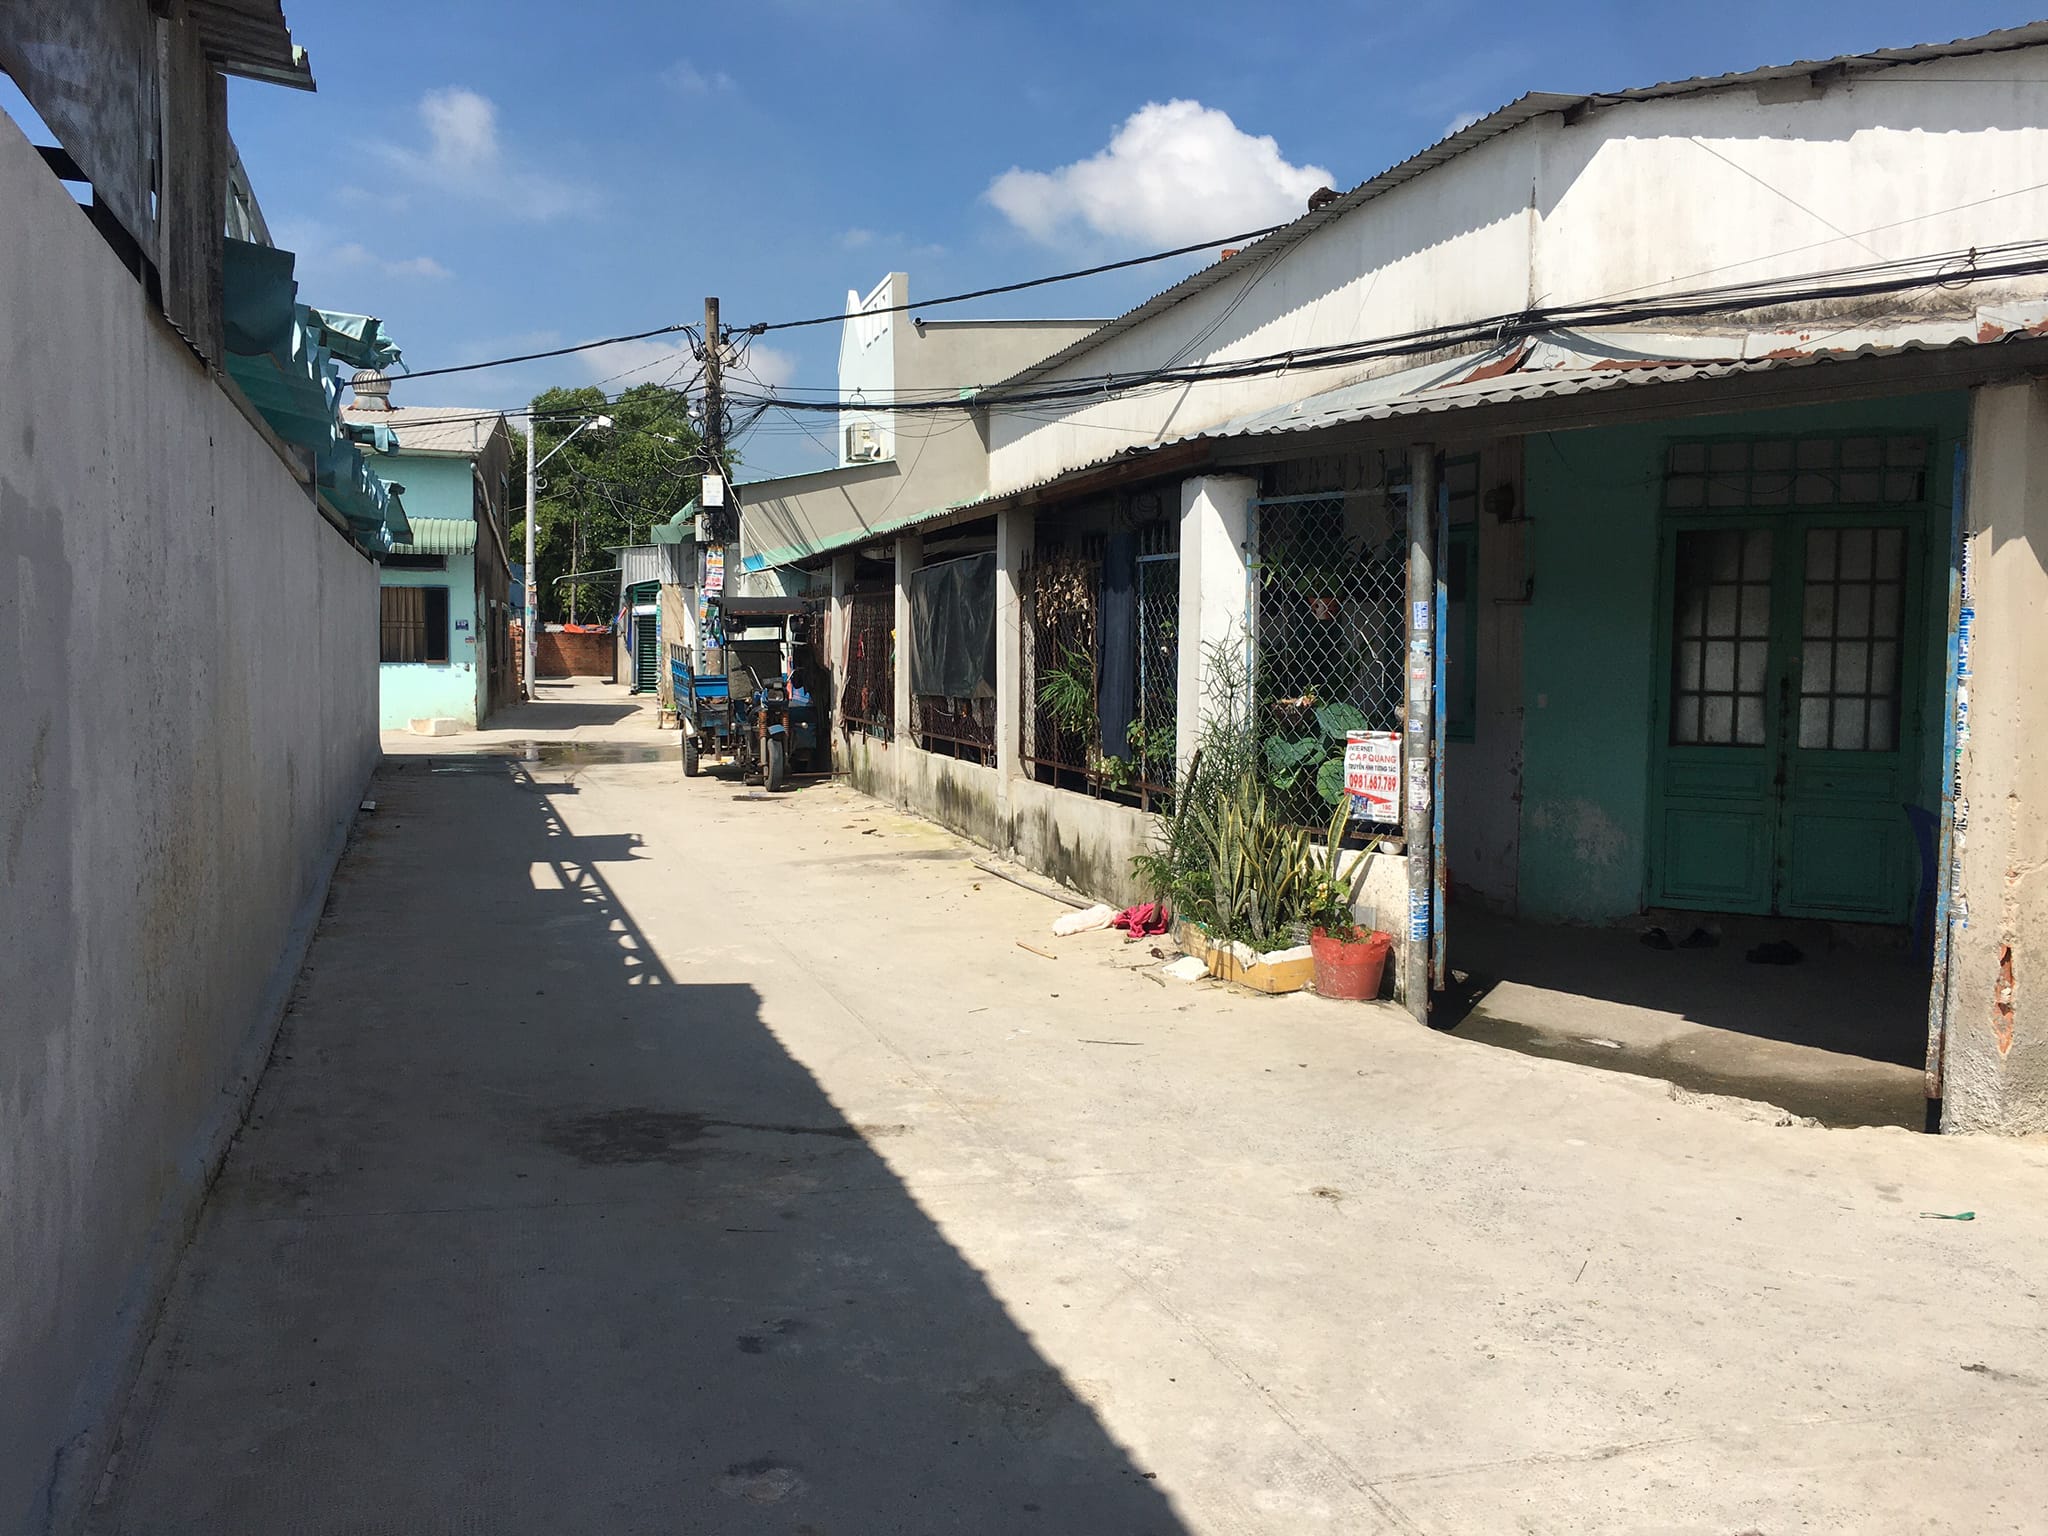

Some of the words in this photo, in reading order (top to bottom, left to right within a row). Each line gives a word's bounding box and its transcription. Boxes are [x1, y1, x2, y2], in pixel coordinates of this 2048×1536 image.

[1348, 745, 1373, 753] INTERNET
[1368, 754, 1396, 764] QUANG
[1348, 774, 1397, 791] 0981.687.789
